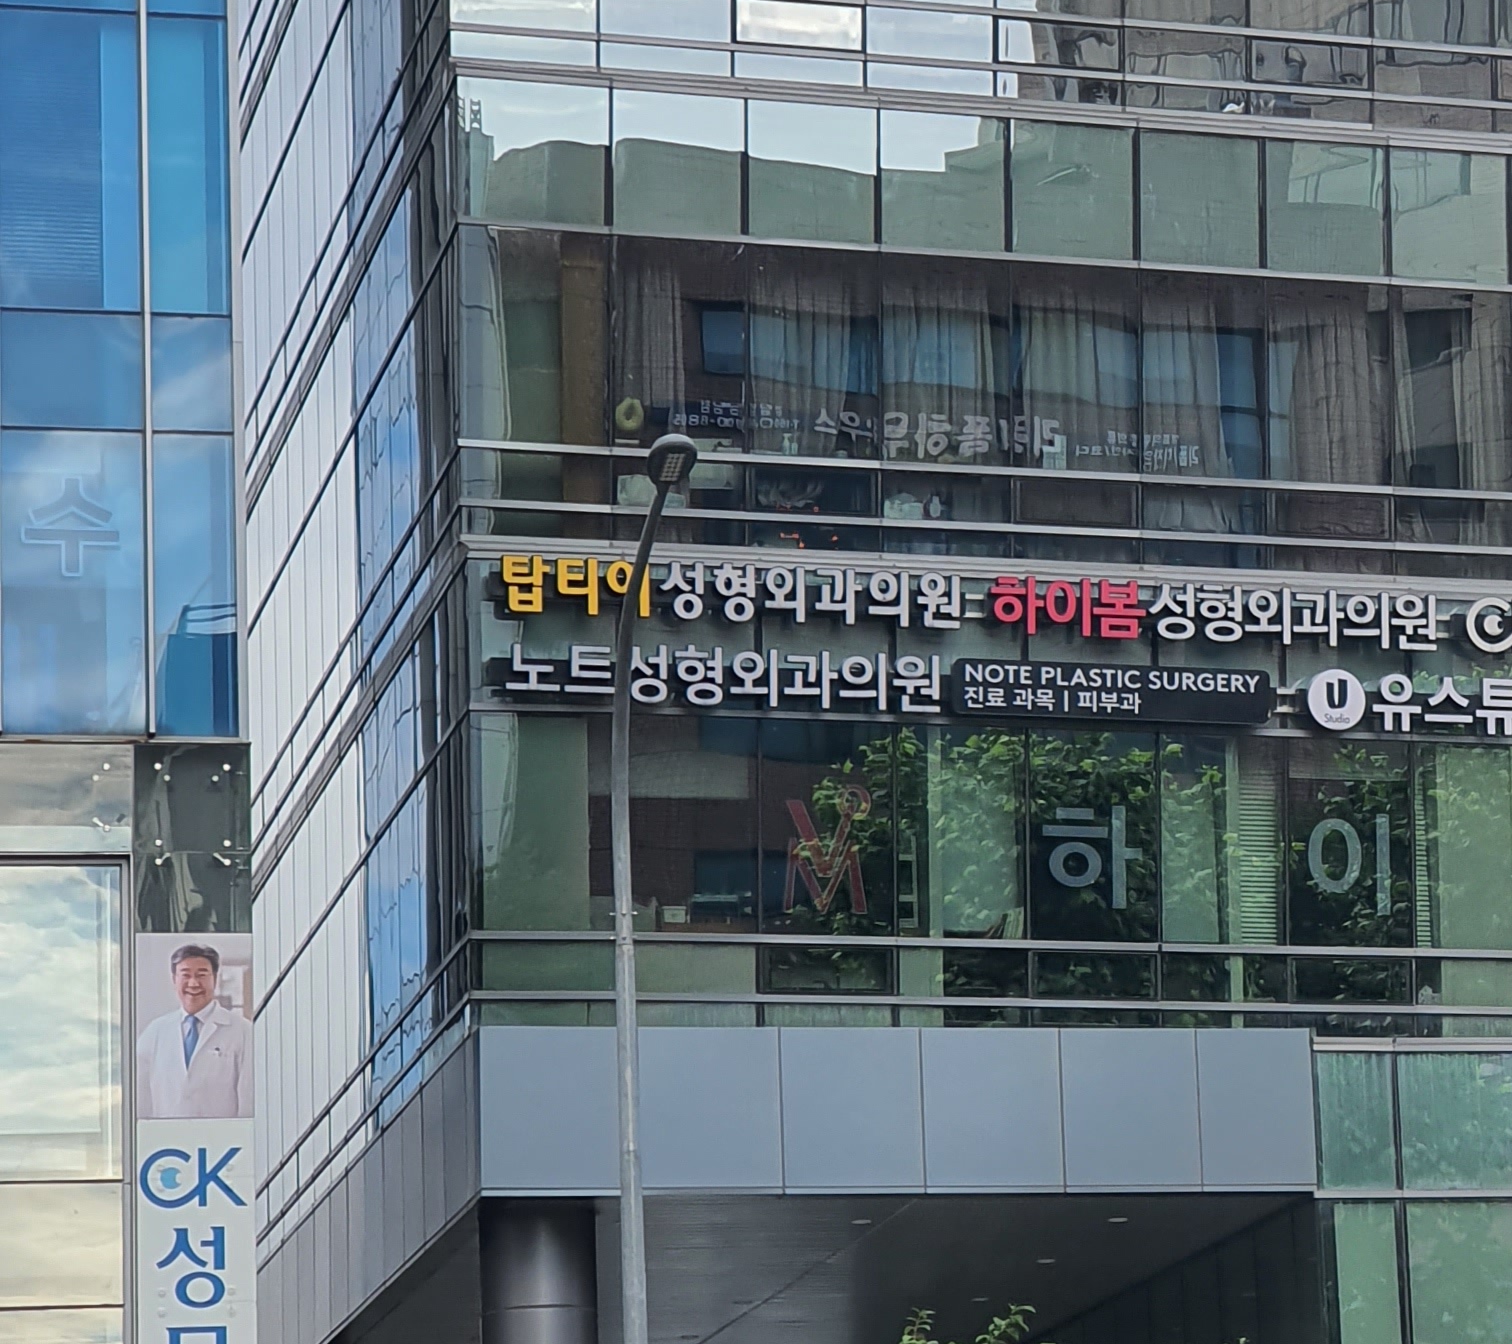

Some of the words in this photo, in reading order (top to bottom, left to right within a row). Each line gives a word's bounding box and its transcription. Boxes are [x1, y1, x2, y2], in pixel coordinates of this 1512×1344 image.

[963, 663, 1037, 688] NOTE
[1040, 666, 1143, 691] PLASTIC
[1147, 670, 1261, 694] SURGERY
[962, 686, 1007, 709] 진료
[1012, 688, 1056, 712] 과목
[1076, 690, 1143, 715] 피부과
[1323, 712, 1351, 725] Studio
[139, 1146, 248, 1209] CK
